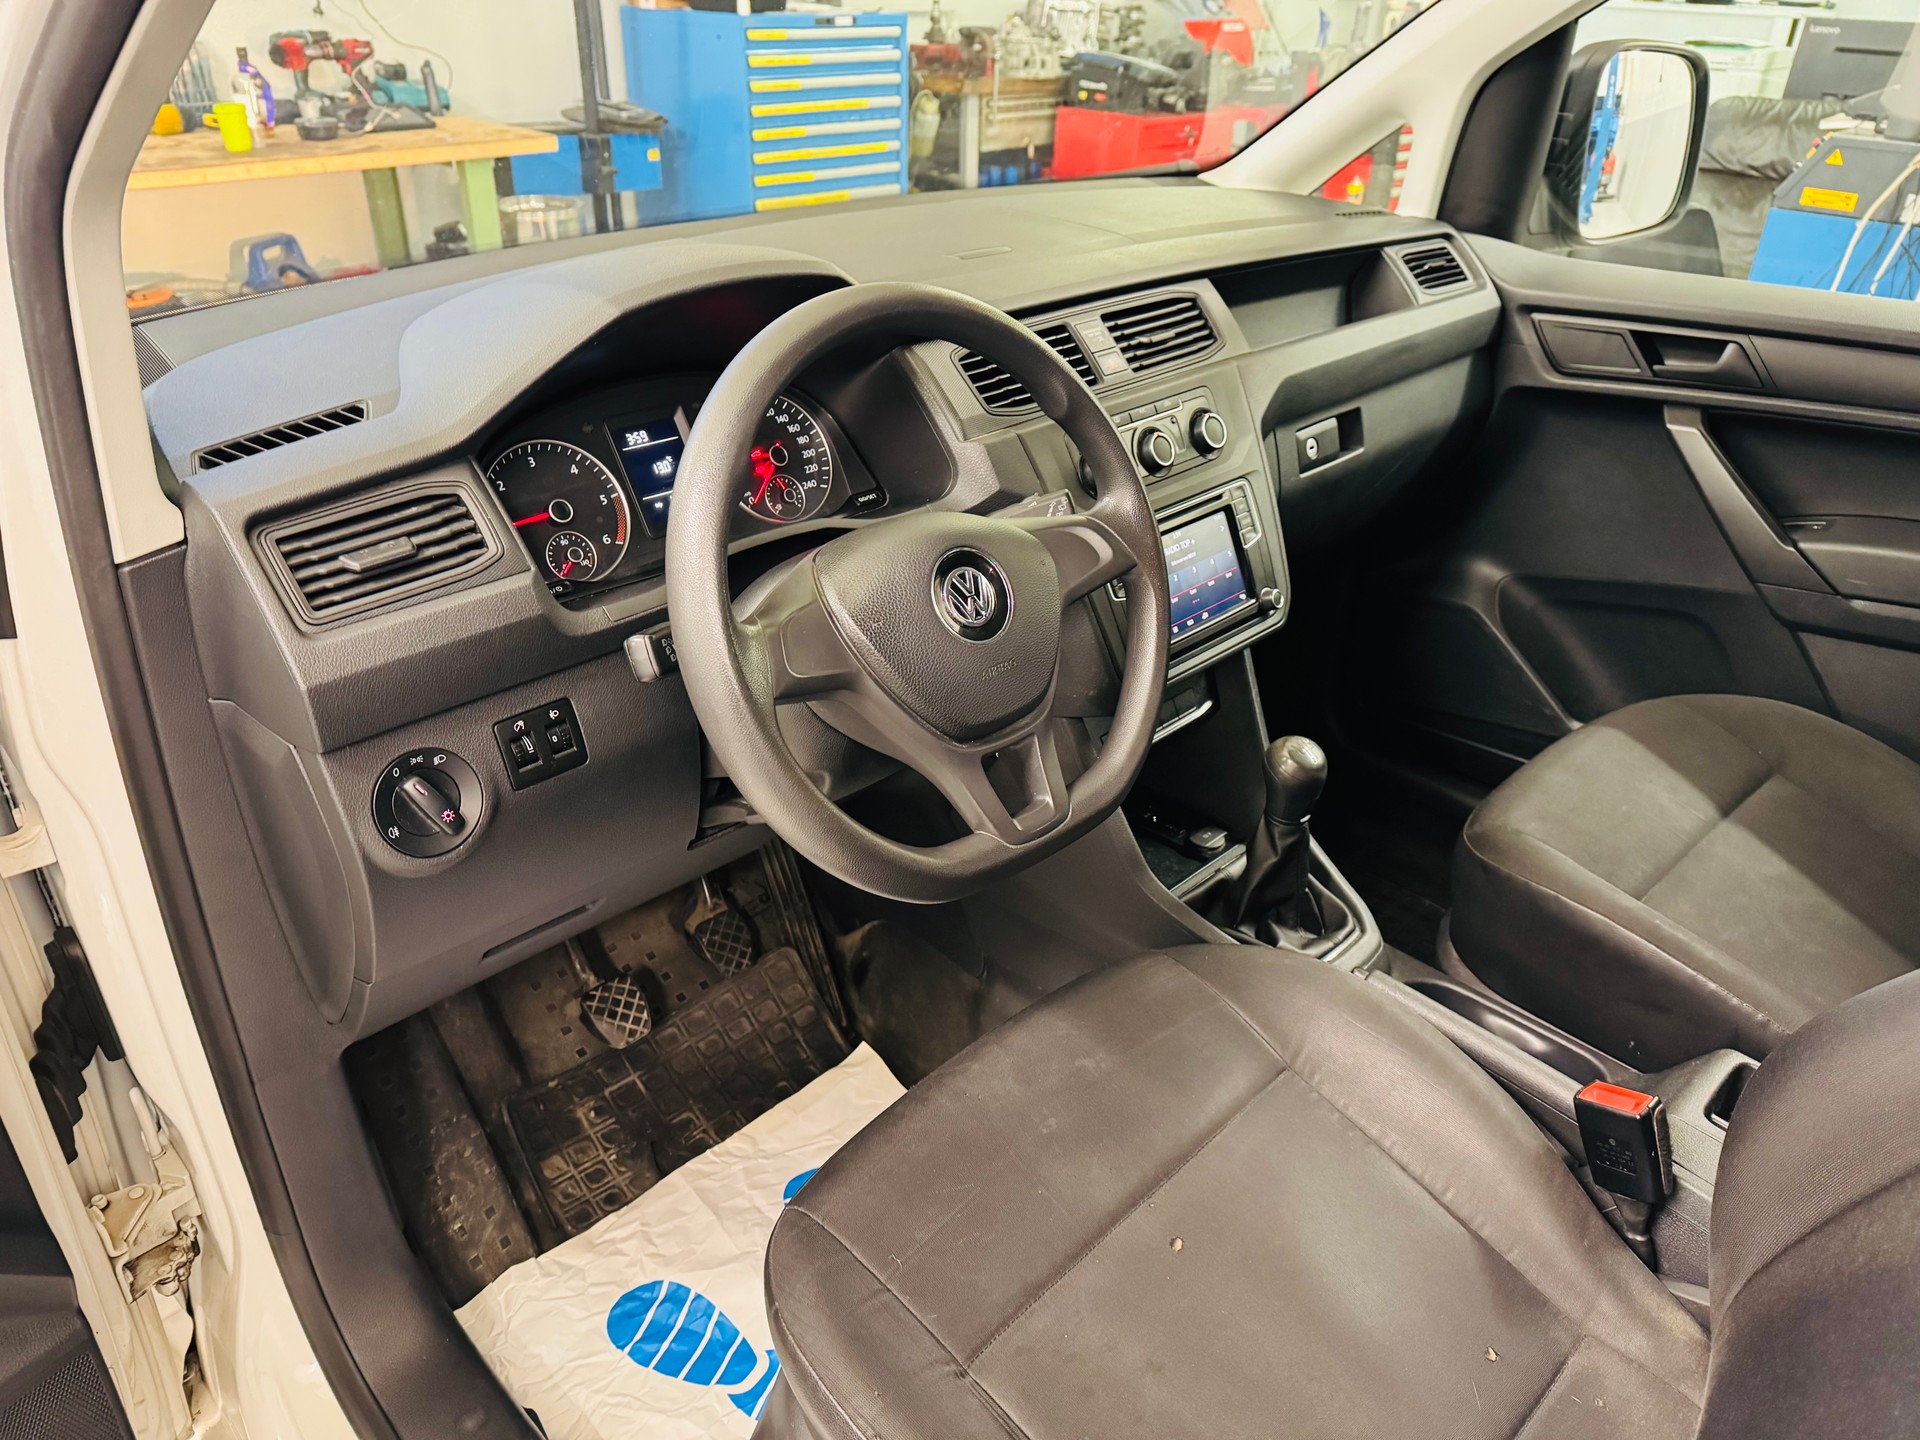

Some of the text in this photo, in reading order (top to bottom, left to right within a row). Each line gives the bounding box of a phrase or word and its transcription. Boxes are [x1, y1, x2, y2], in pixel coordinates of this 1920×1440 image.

[775, 413, 789, 424] 140
[786, 423, 801, 434] 160
[796, 434, 810, 445] 180
[801, 448, 816, 459] 200
[527, 456, 536, 468] 3
[570, 464, 579, 475] 4
[804, 463, 819, 474] 220
[496, 480, 506, 492] 2
[802, 479, 817, 490] 240
[599, 494, 608, 506] 5
[602, 534, 612, 545] 6
[392, 767, 400, 777] 0
